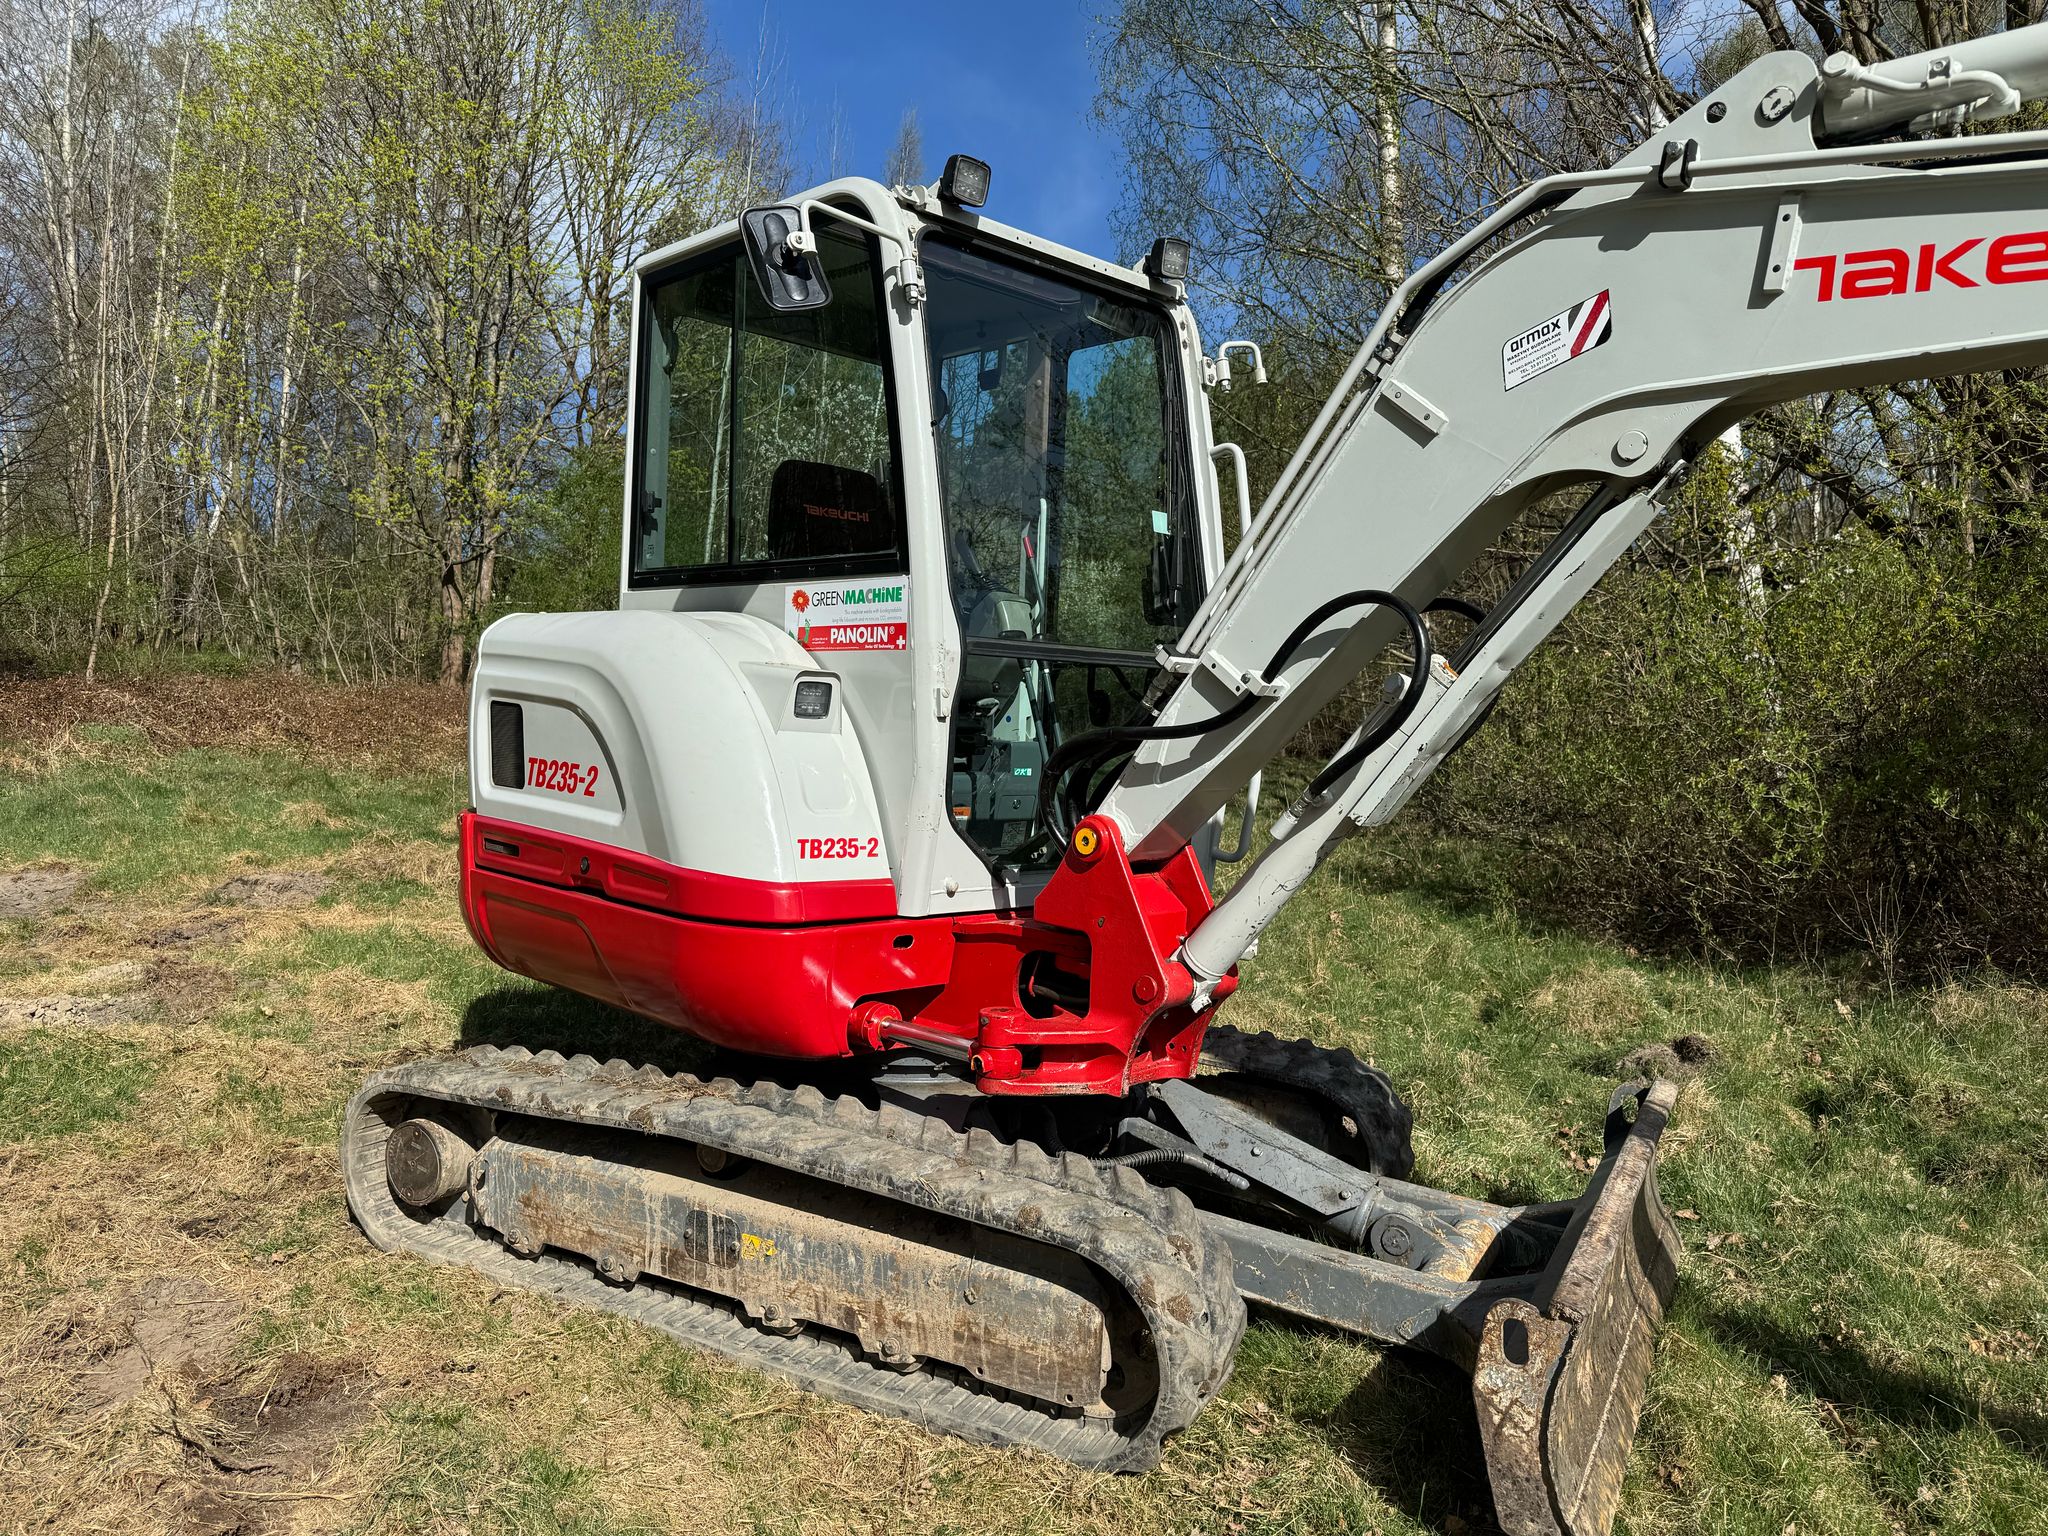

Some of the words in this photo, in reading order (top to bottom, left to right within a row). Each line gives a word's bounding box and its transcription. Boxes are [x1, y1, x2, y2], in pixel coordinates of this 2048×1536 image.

[1506, 348, 1529, 362] MASZYNY
[1530, 331, 1562, 350] BUDOWLANE
[1510, 318, 1561, 353] armax
[527, 757, 599, 797] TB235-2
[797, 837, 879, 860] TB235-2
